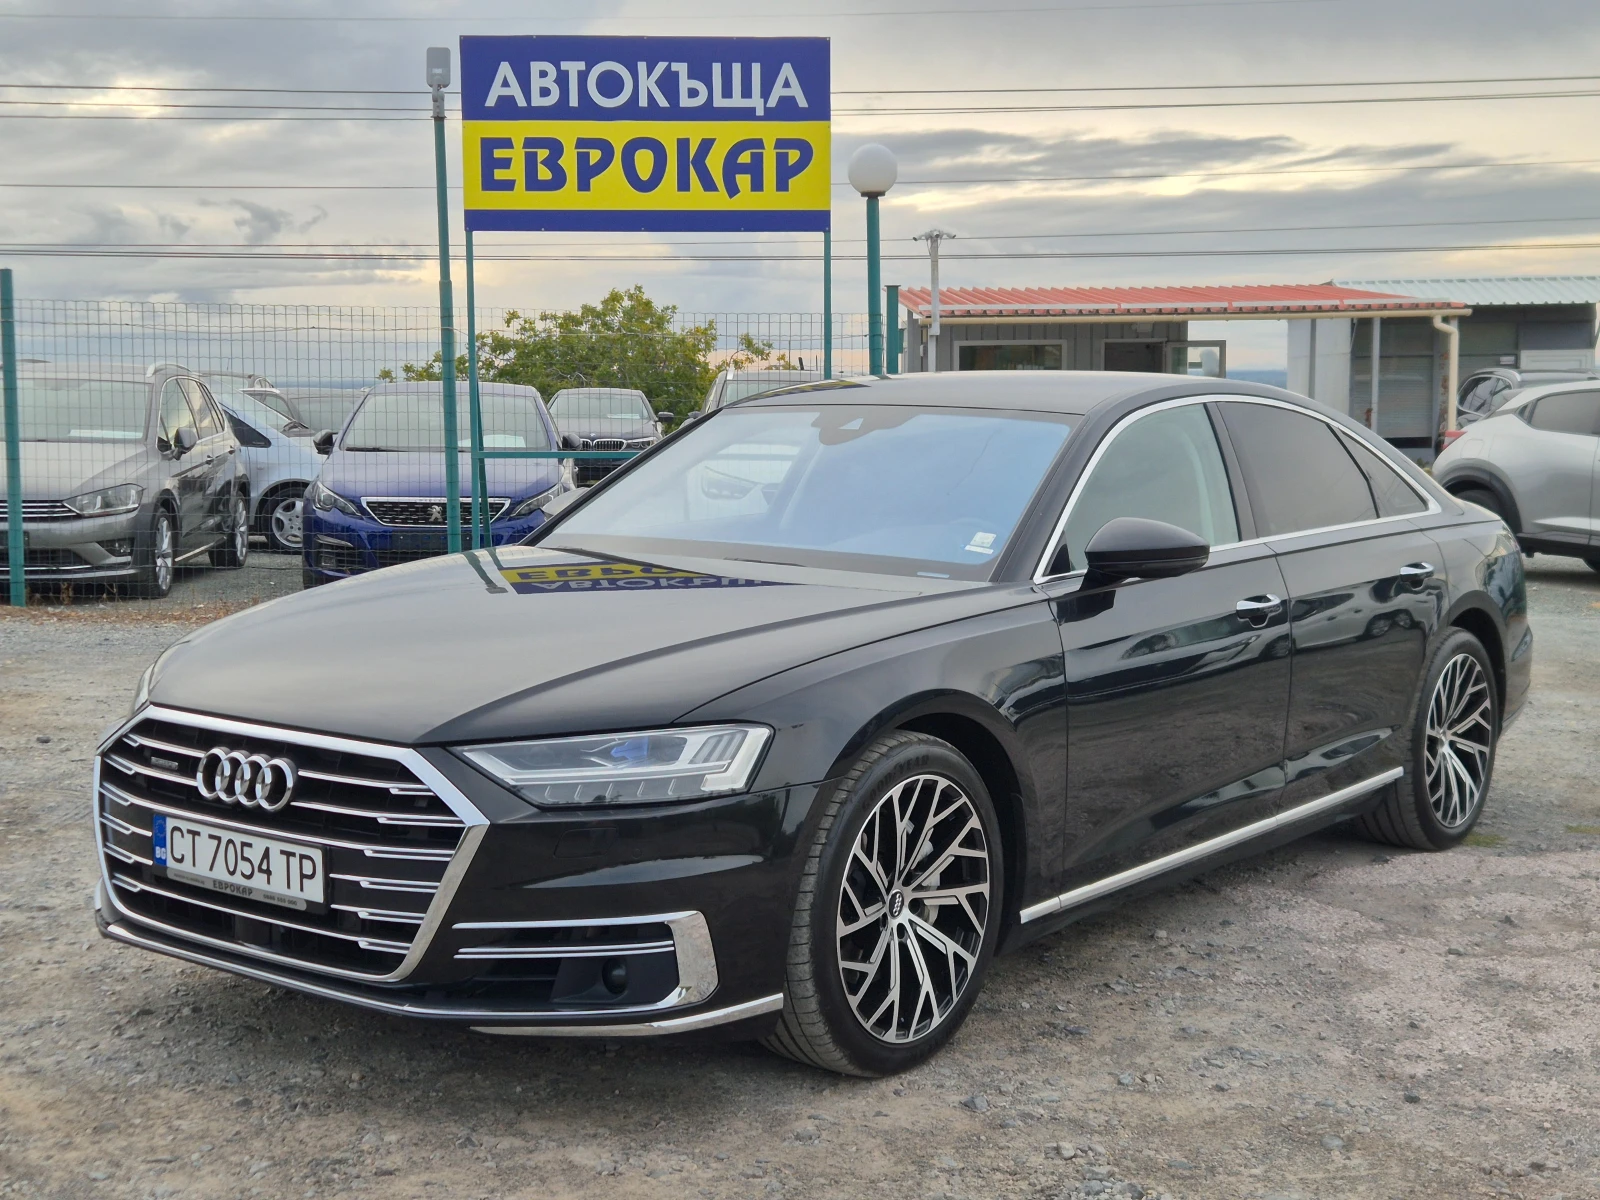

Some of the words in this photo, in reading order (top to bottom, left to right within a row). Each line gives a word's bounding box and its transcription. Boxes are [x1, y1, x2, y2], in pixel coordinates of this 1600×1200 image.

[484, 61, 809, 116] АВТОКЪЩА
[480, 137, 814, 199] ЕВРОКАР
[155, 846, 167, 860] BG
[170, 825, 201, 868] CT
[208, 833, 272, 885] 7054
[280, 849, 317, 893] TP
[212, 880, 254, 897] ЕВРОКАР
